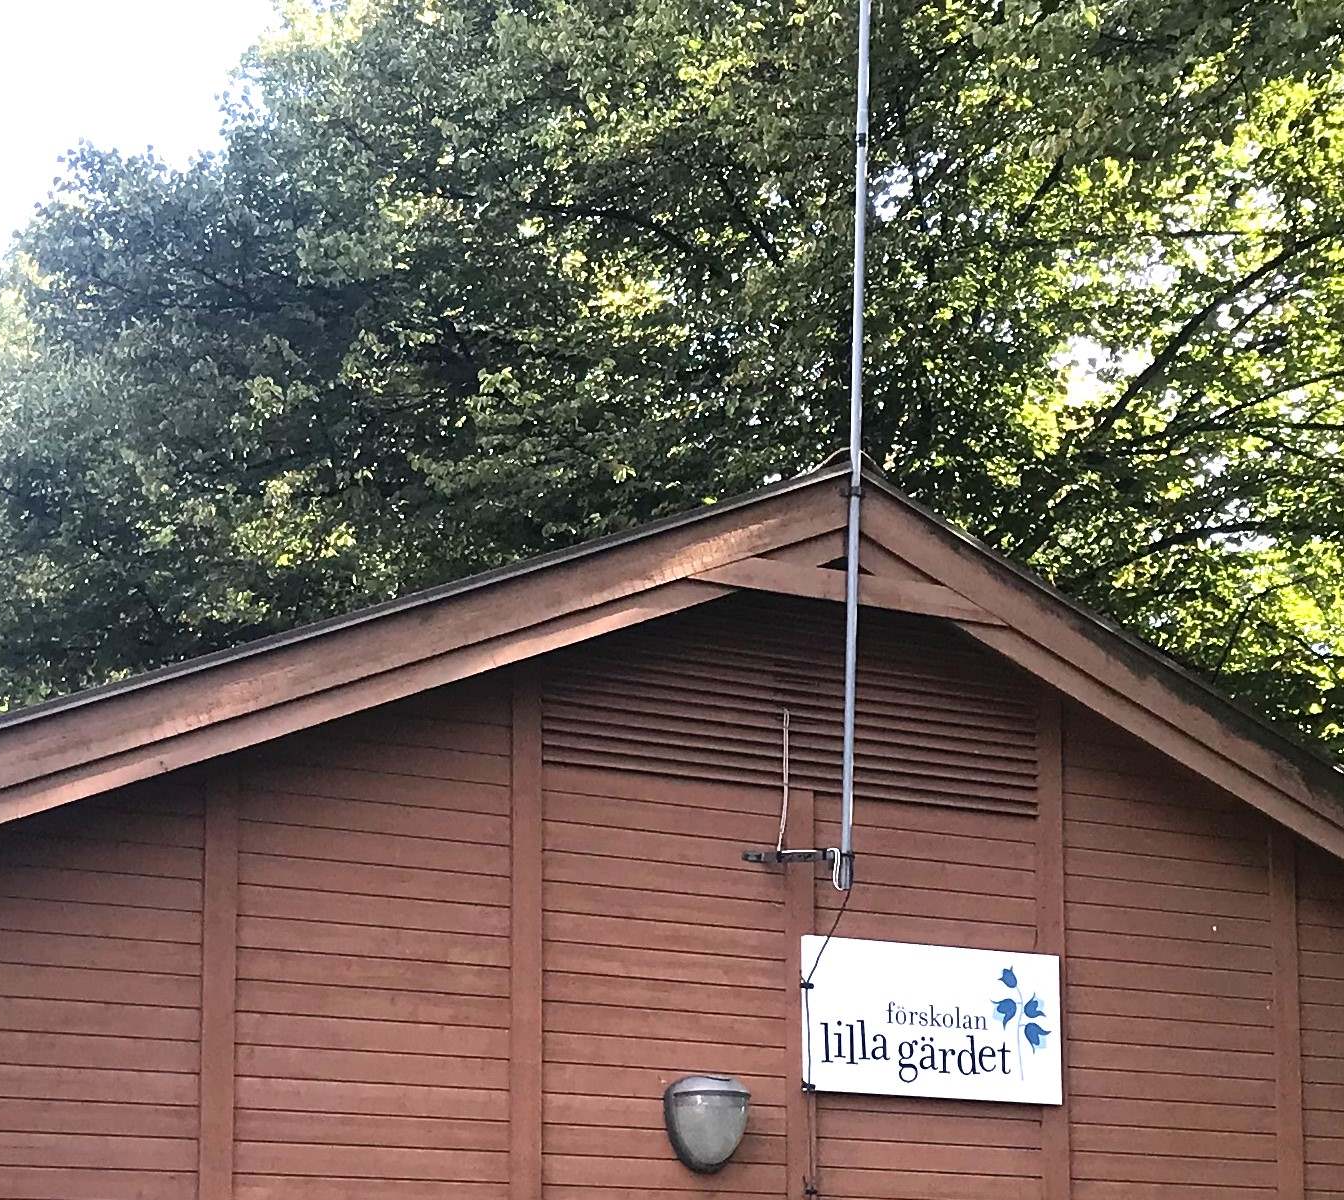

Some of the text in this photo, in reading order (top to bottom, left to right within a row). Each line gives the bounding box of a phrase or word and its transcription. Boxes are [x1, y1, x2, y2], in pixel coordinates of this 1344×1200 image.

[885, 1001, 988, 1031] förskolan
[820, 1019, 1012, 1083] lilla gärdet
